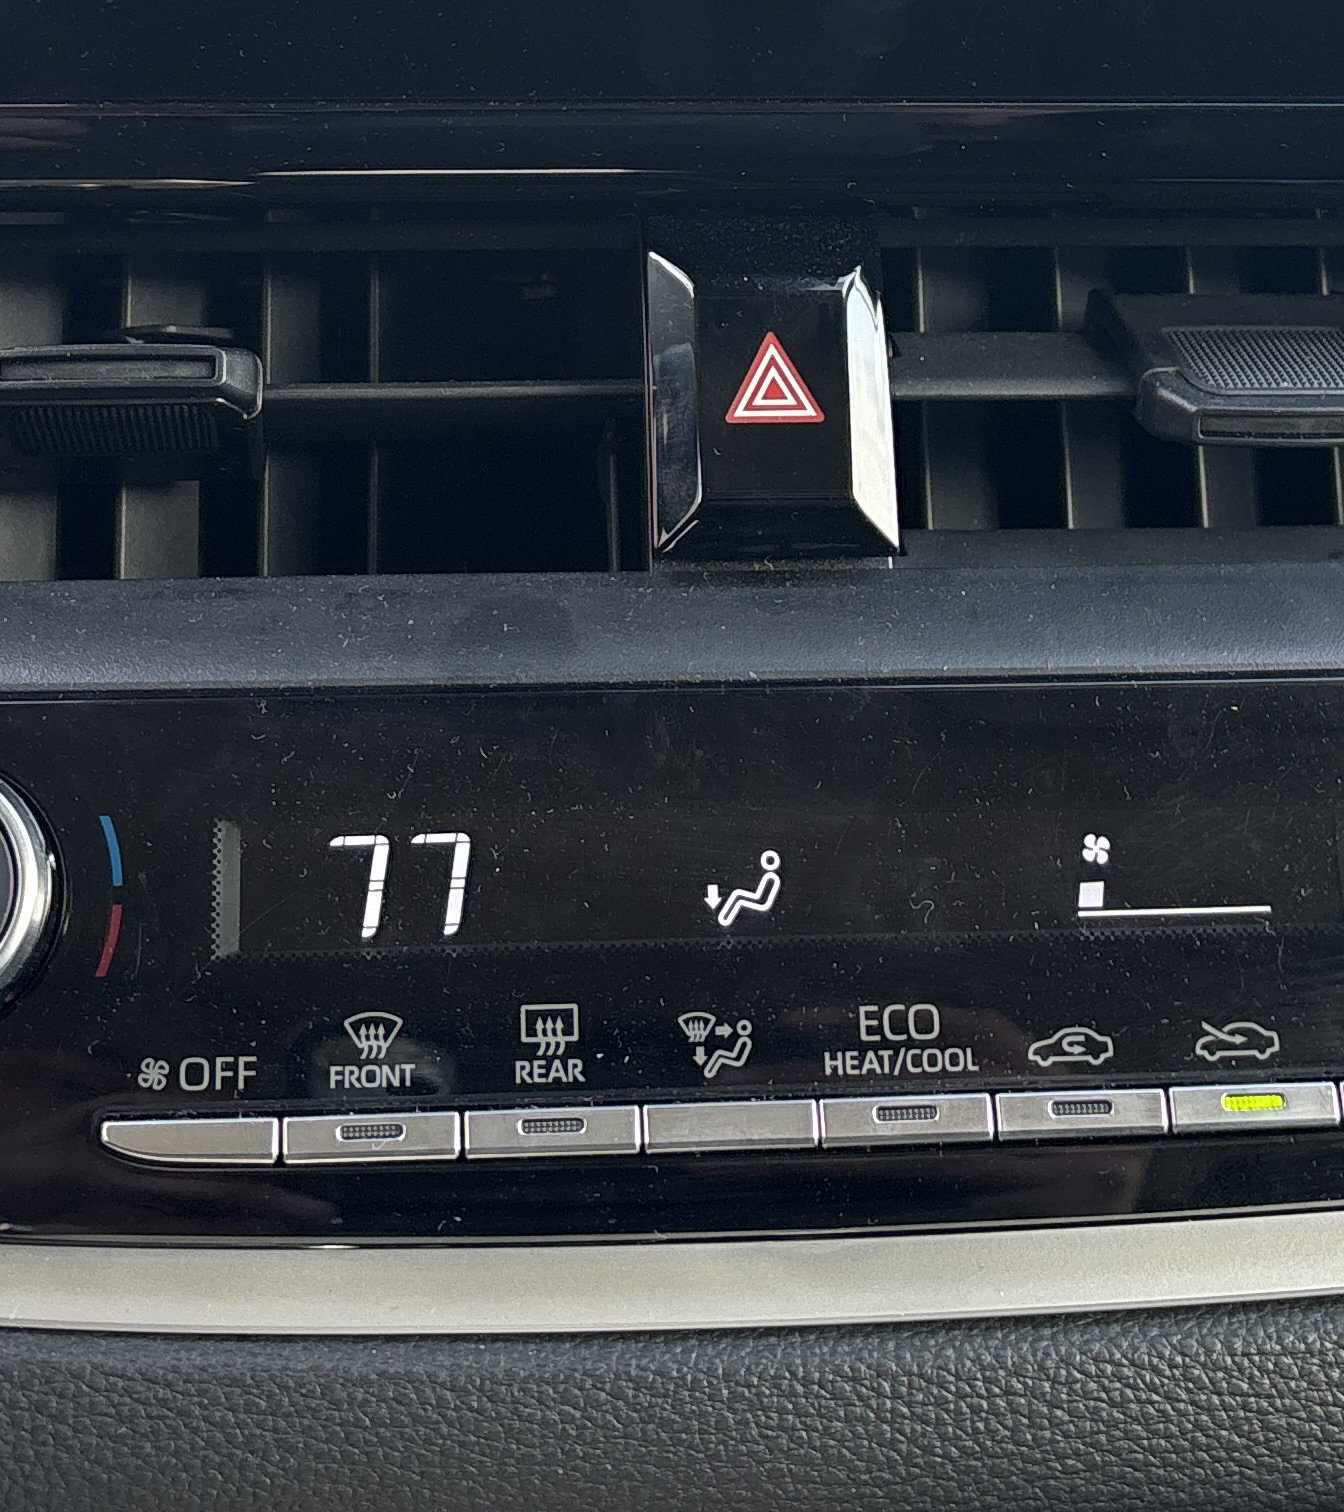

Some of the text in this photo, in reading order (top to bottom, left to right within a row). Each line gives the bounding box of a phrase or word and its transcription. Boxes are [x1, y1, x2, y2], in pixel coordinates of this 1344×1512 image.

[329, 832, 471, 939] 77
[858, 1003, 941, 1042] ECO
[179, 1055, 258, 1092] OFF
[329, 1063, 416, 1090] FRONT
[514, 1058, 586, 1084] REAR
[824, 1047, 980, 1076] HEAT/COOL
